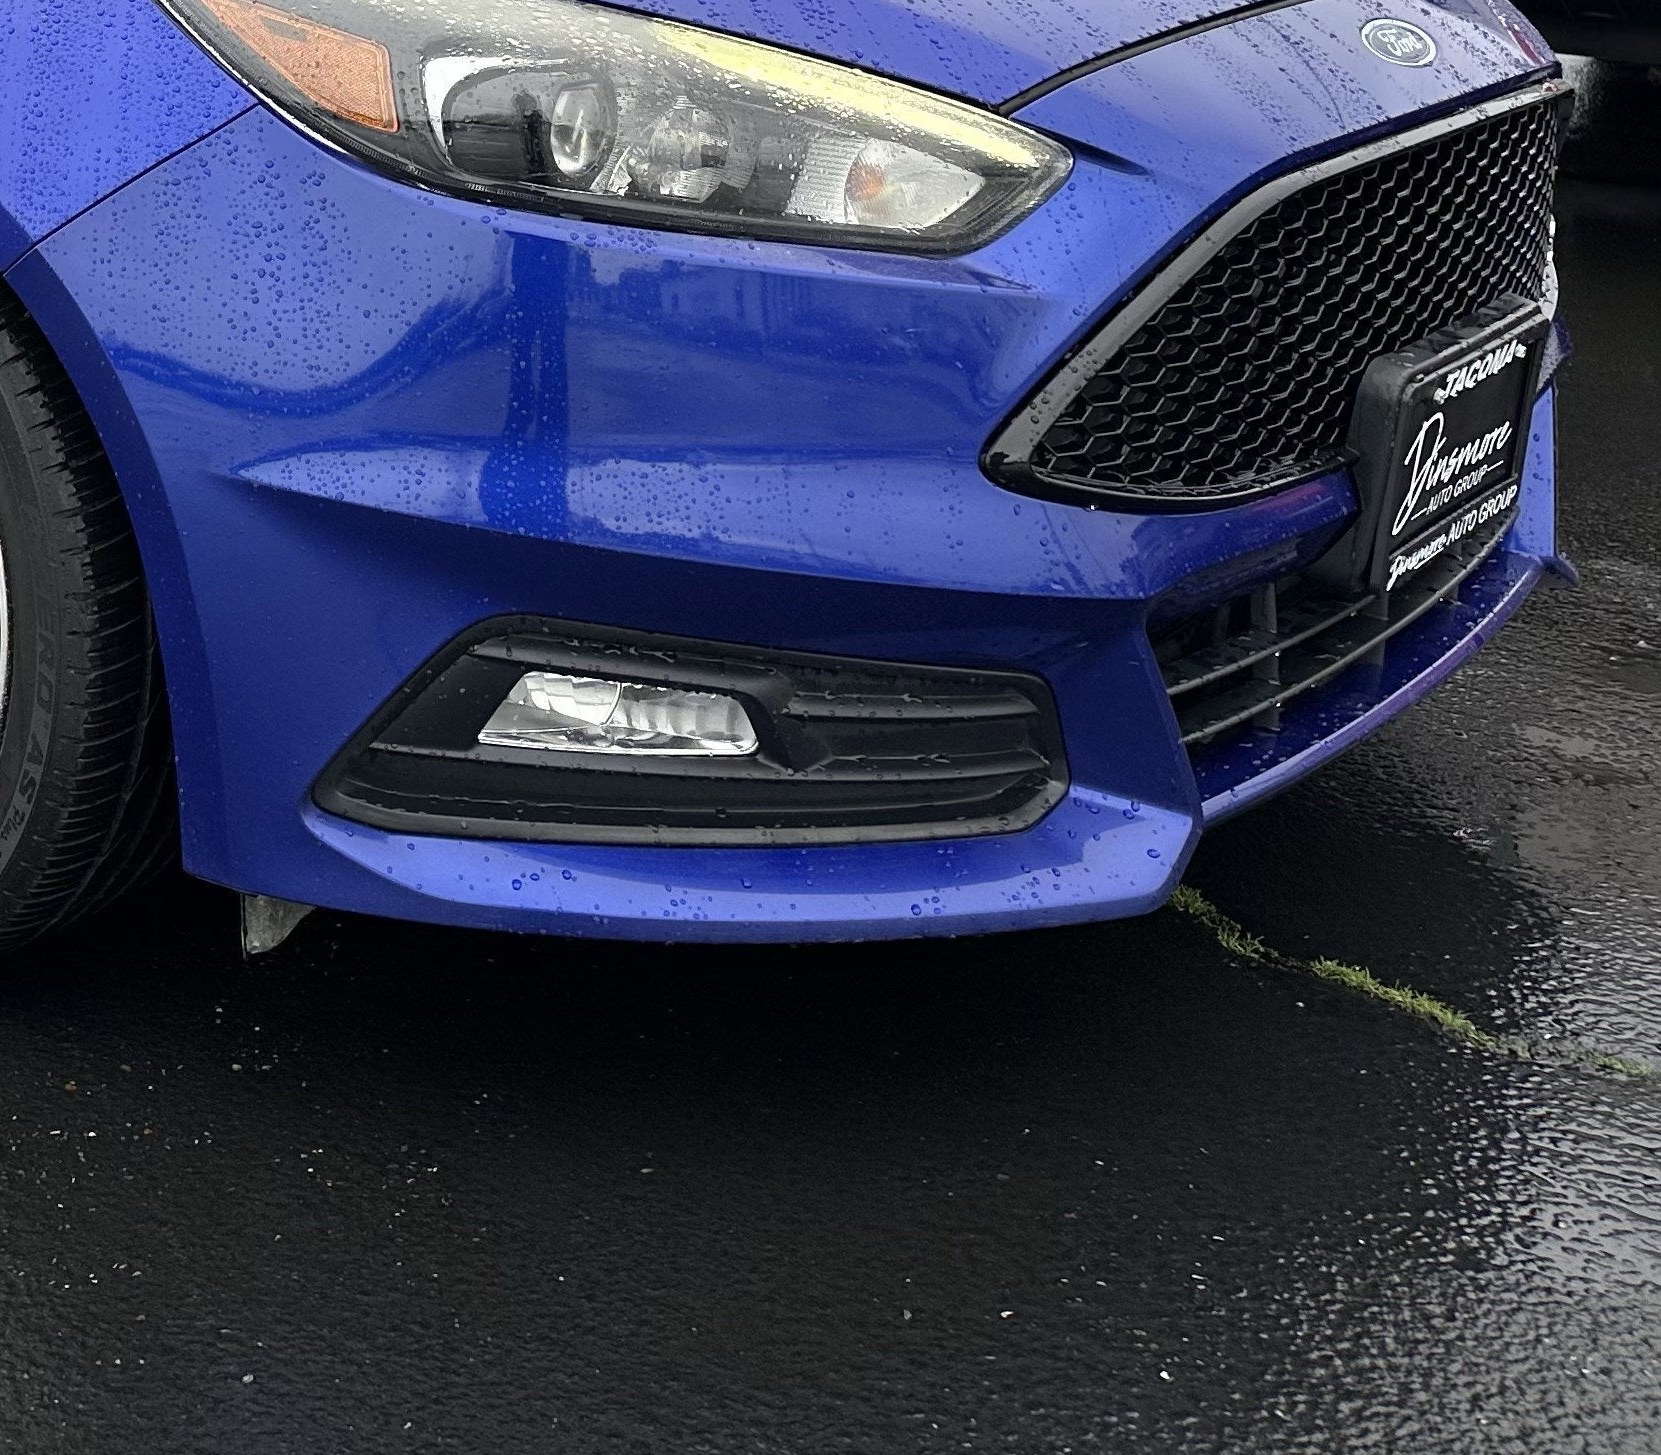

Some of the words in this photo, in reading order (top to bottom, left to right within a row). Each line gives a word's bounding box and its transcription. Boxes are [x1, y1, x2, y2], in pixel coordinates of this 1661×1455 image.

[1376, 28, 1423, 56] Ford
[1443, 339, 1517, 399] TACOMA
[1391, 411, 1513, 536] Dinsmore
[1426, 484, 1453, 516] AUTO
[1453, 464, 1489, 498] GROUP
[1386, 533, 1447, 592] Dinsmore
[1445, 509, 1478, 546] AUTO
[1478, 484, 1518, 525] GROUP
